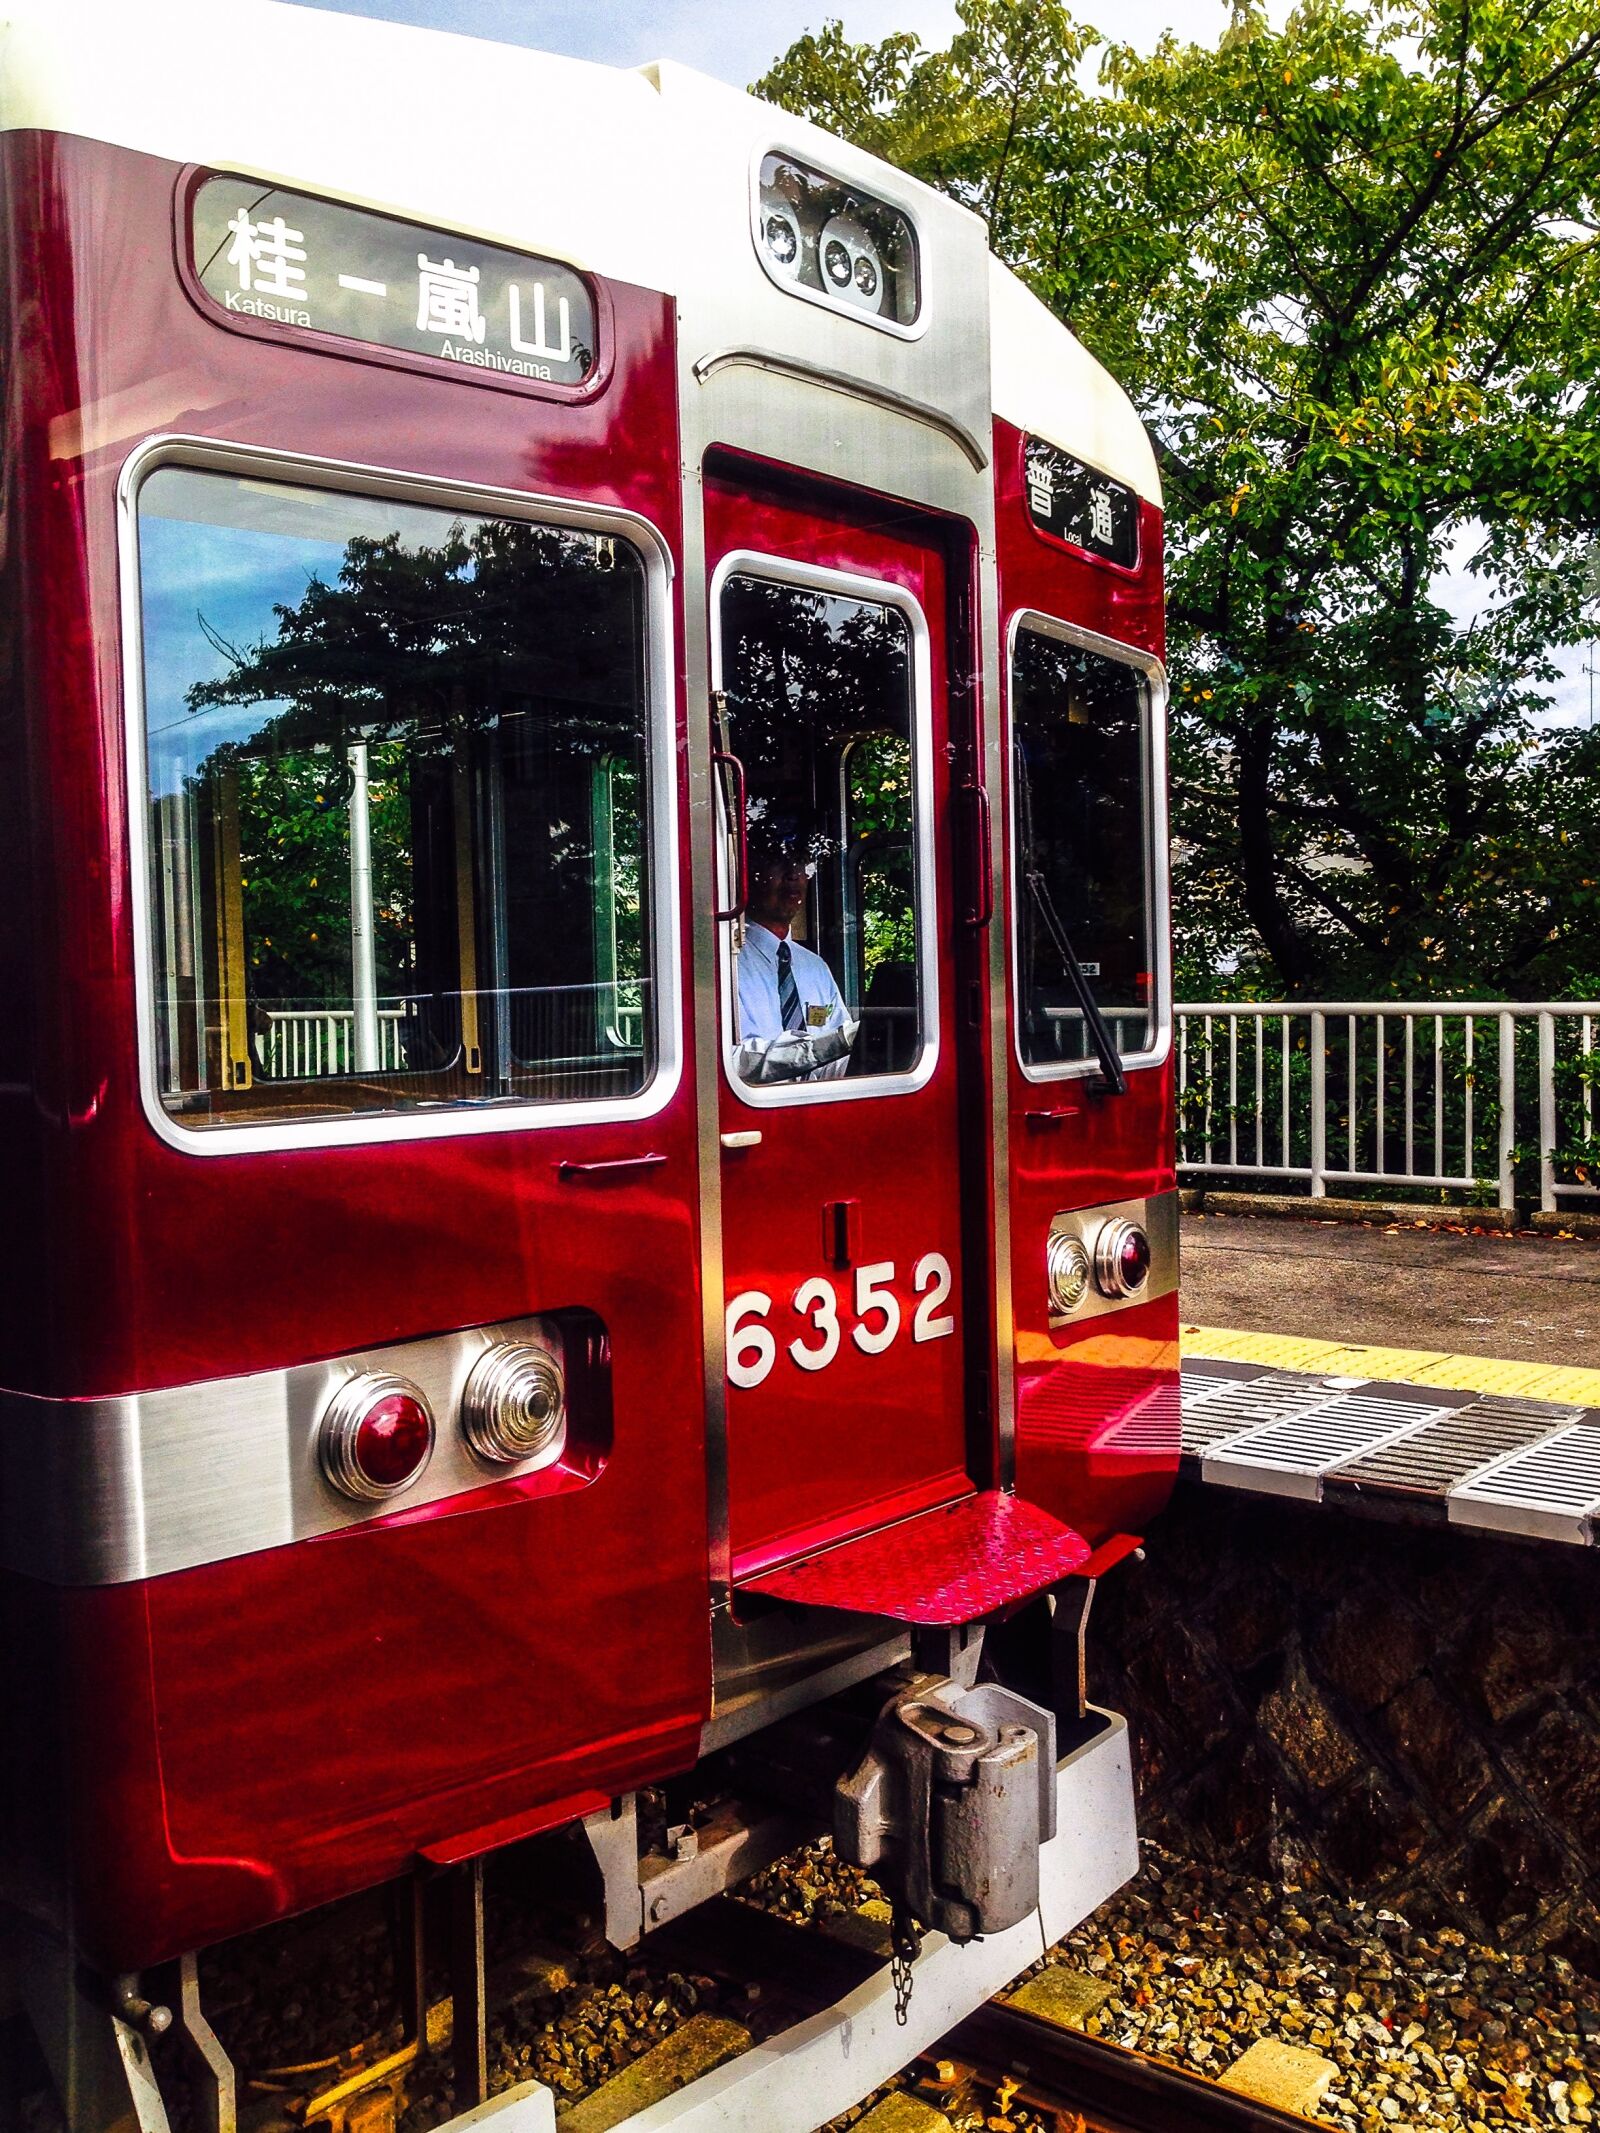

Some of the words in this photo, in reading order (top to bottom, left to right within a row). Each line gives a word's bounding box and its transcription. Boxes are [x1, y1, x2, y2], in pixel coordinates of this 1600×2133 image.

[225, 290, 312, 328] Katsura
[440, 340, 552, 381] Arashiyama
[1064, 527, 1083, 547] Local
[725, 1252, 954, 1388] 6352
